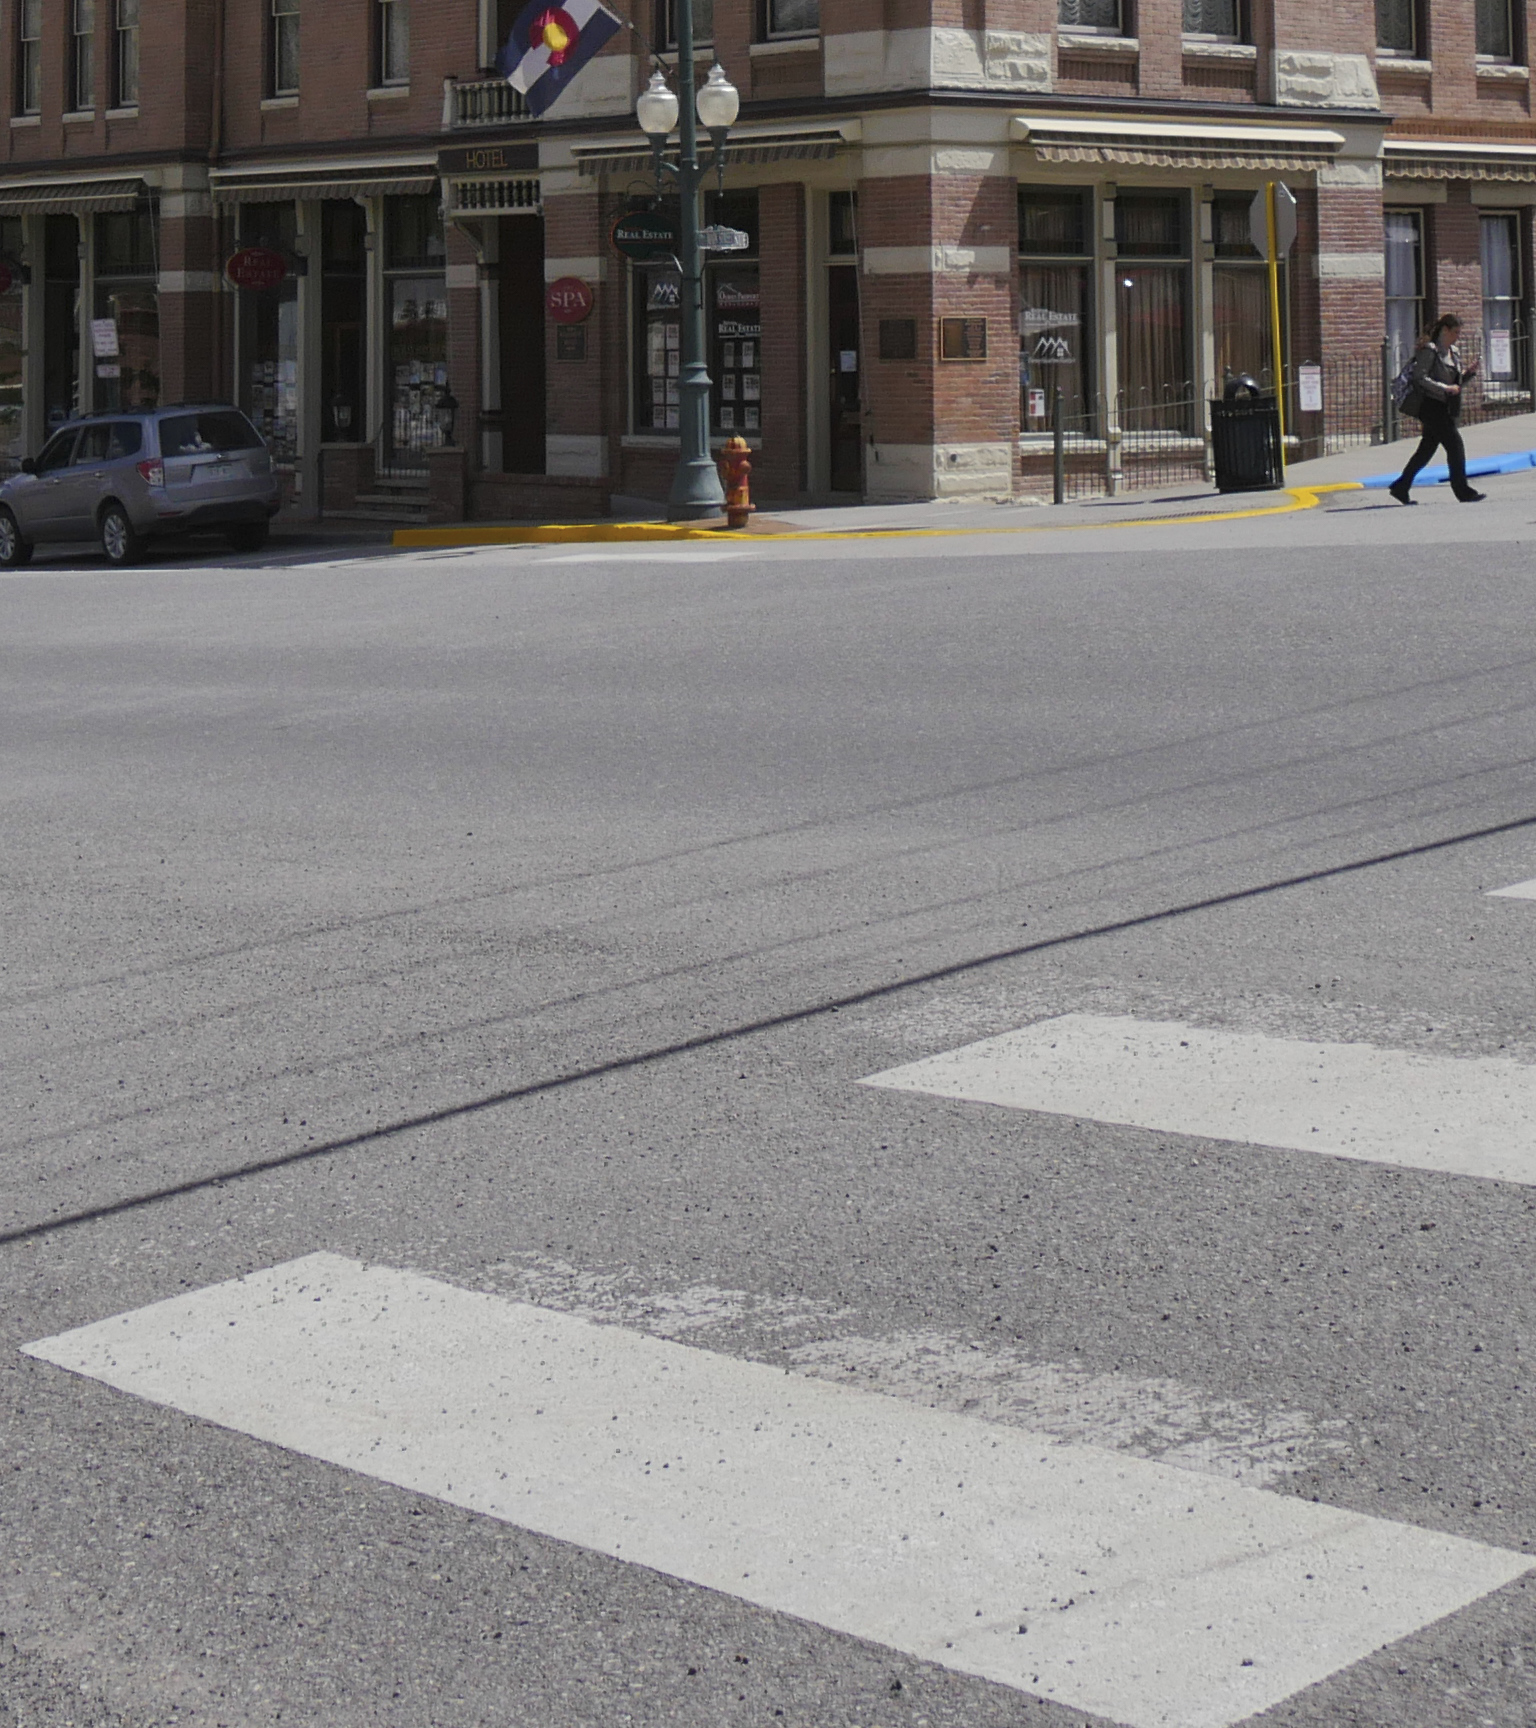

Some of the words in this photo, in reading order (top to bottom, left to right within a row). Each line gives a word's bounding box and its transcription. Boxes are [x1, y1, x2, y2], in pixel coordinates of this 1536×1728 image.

[466, 148, 508, 169] HOTEL
[617, 229, 641, 239] REAL
[643, 230, 673, 239] ESTATE
[550, 292, 586, 308] SPA
[1025, 312, 1047, 321] REAL
[1049, 312, 1078, 321] ESTATE
[718, 323, 736, 333] REAL
